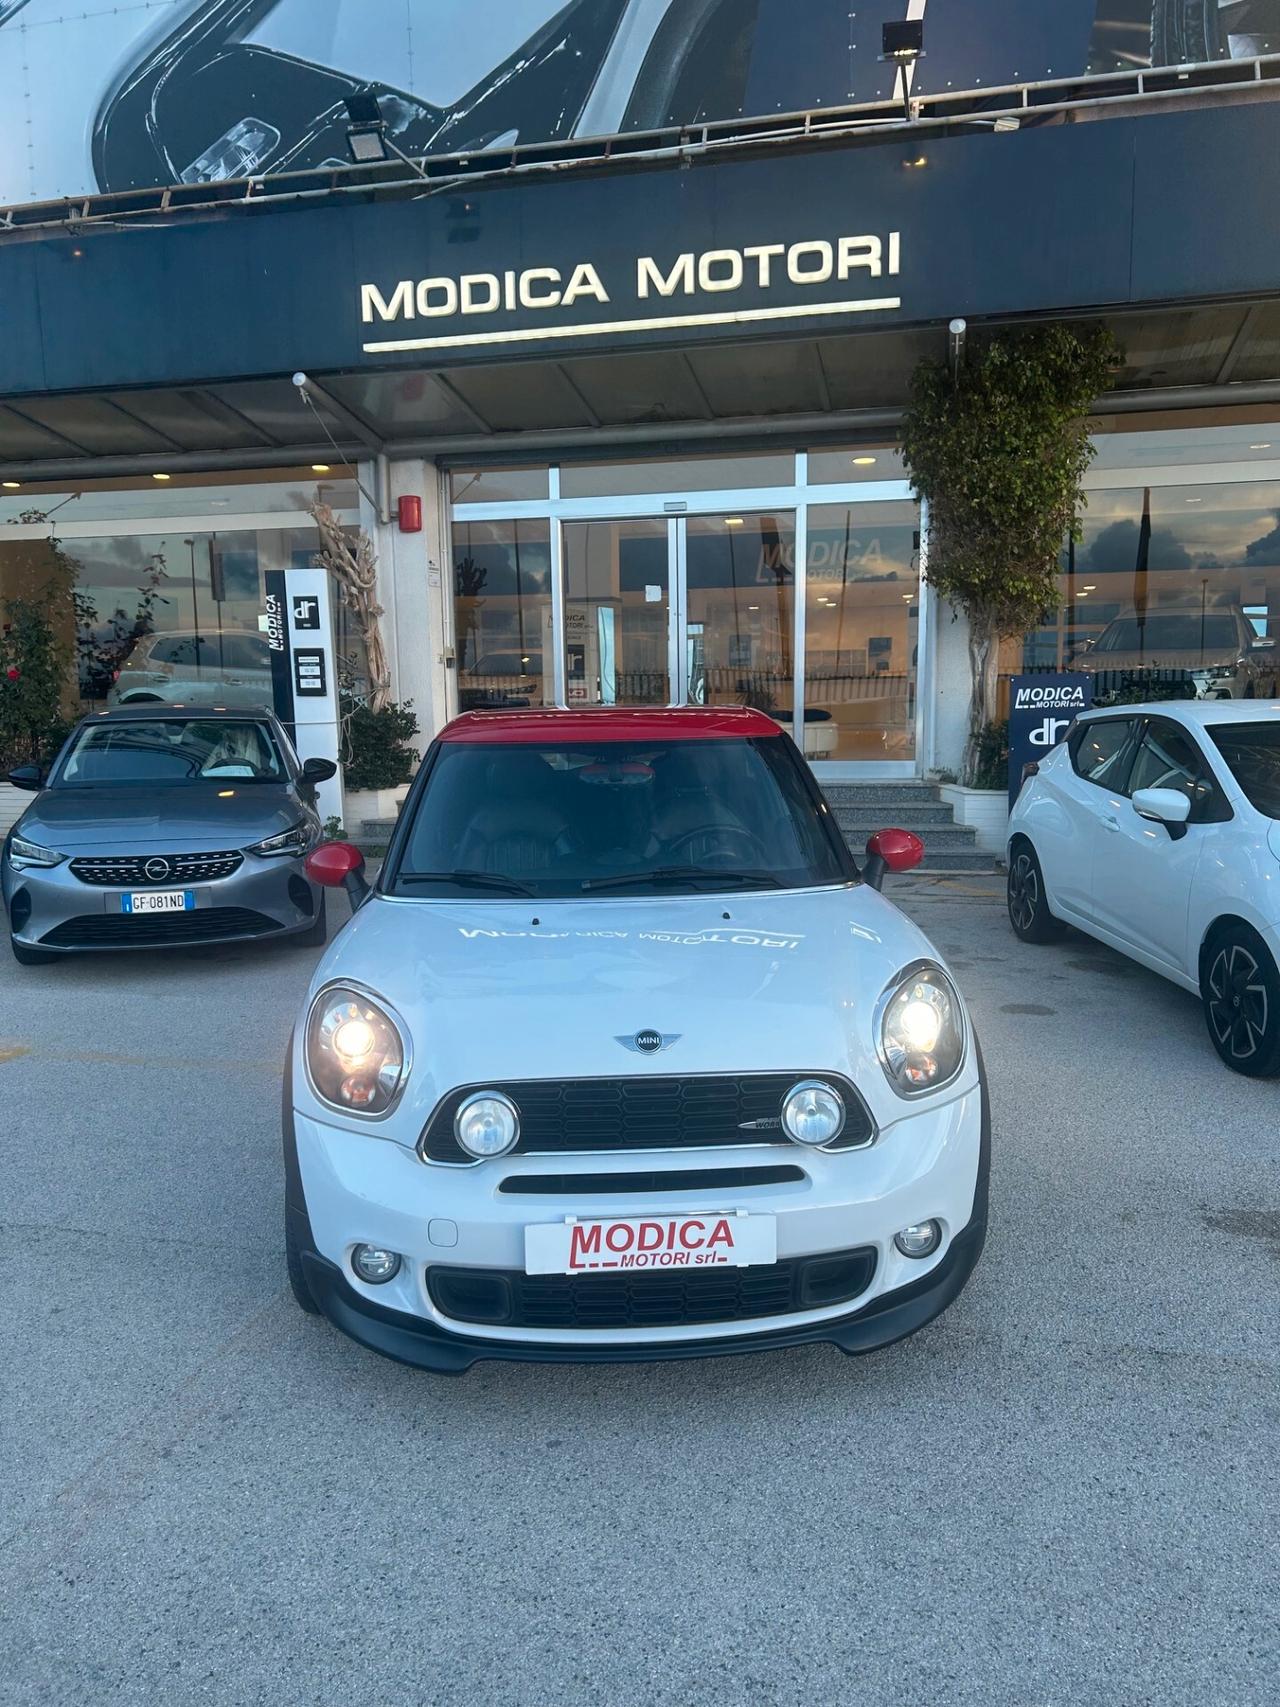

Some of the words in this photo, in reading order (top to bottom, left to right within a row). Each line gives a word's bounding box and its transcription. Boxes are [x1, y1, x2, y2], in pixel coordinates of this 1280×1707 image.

[360, 263, 610, 323] MODICA
[637, 231, 901, 299] MOTORI
[294, 600, 316, 619] dr
[266, 594, 280, 650] MODICA
[1016, 686, 1084, 703] MODICA
[1036, 700, 1069, 708] MOTORI
[1028, 717, 1070, 746] dr
[637, 1036, 660, 1045] MINI
[570, 1219, 735, 1256] MODICA
[620, 1251, 690, 1268] MOTORI
[694, 1250, 718, 1265] srl
